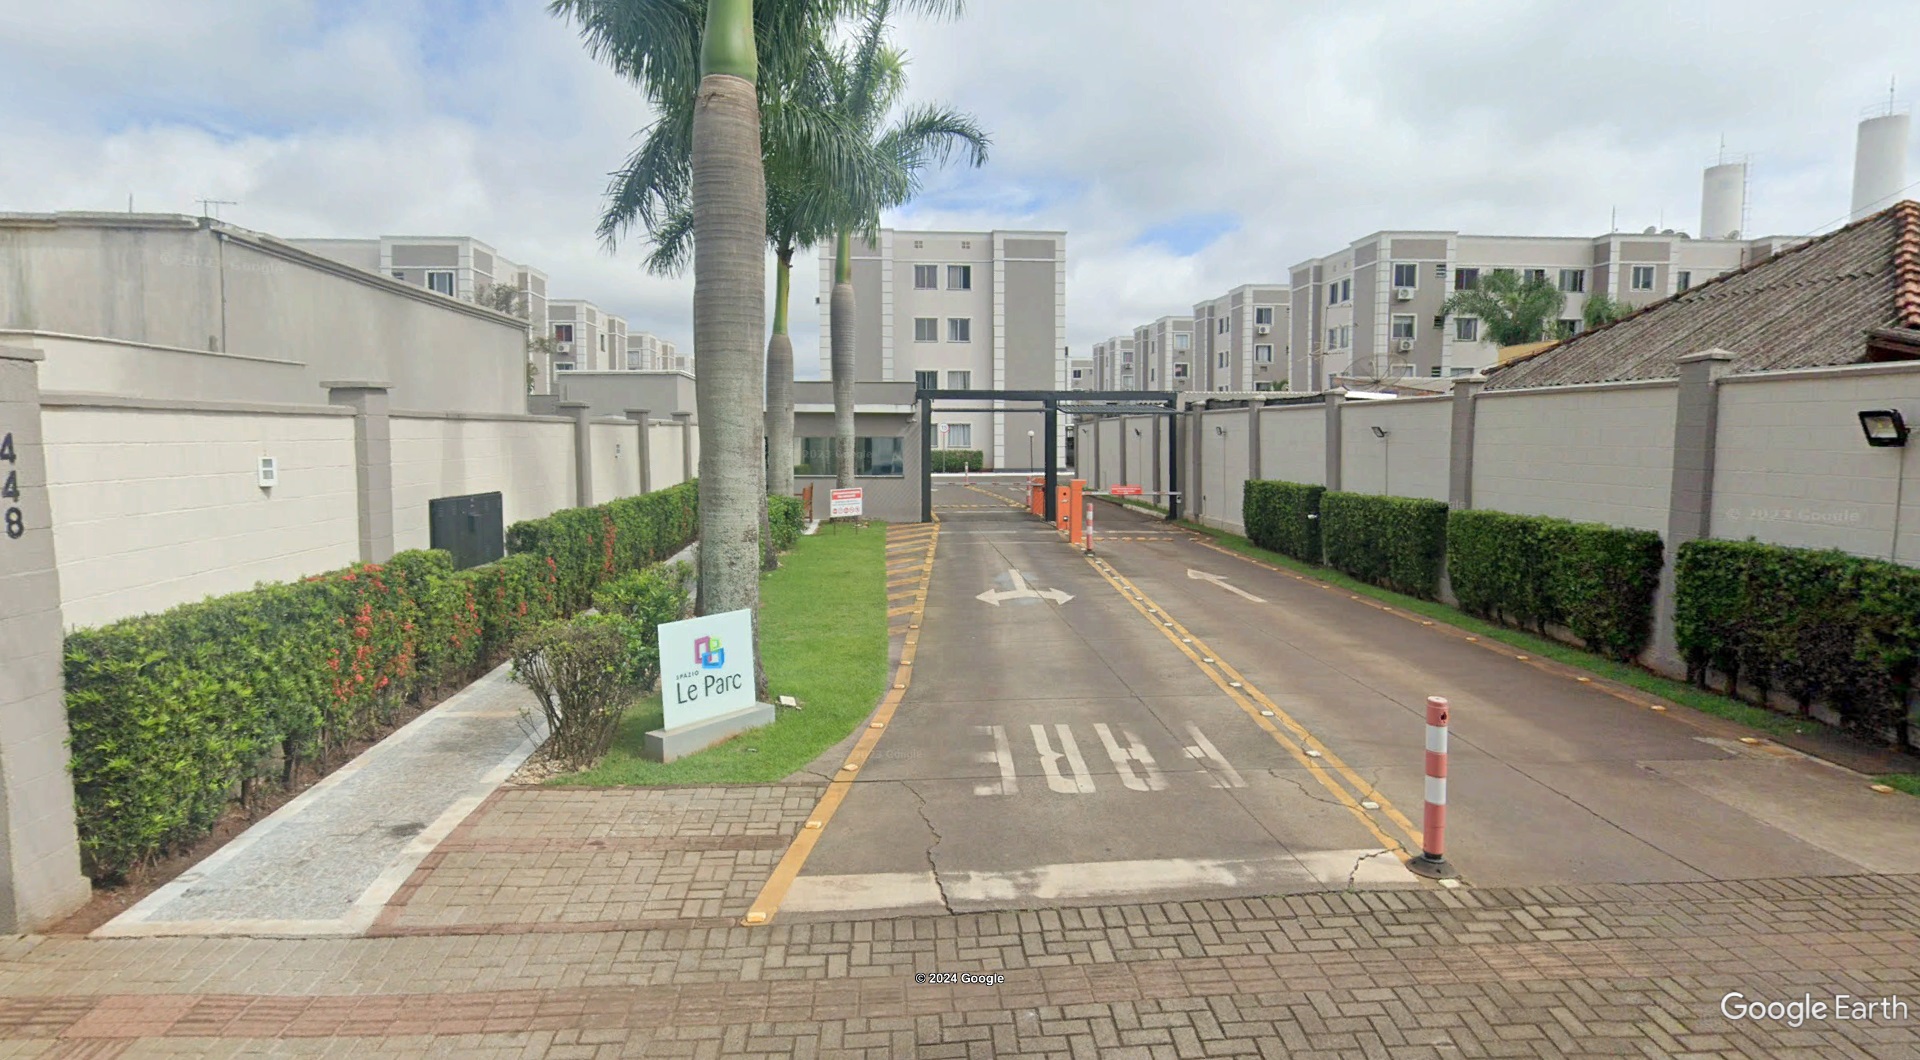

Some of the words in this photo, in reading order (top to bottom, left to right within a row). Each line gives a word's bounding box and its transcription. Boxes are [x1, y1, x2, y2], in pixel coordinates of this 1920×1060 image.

[0, 432, 24, 539] 448
[676, 670, 699, 680] SPAZIO
[676, 682, 698, 704] Le
[704, 673, 742, 697] Parc
[973, 720, 1249, 796] PARE
